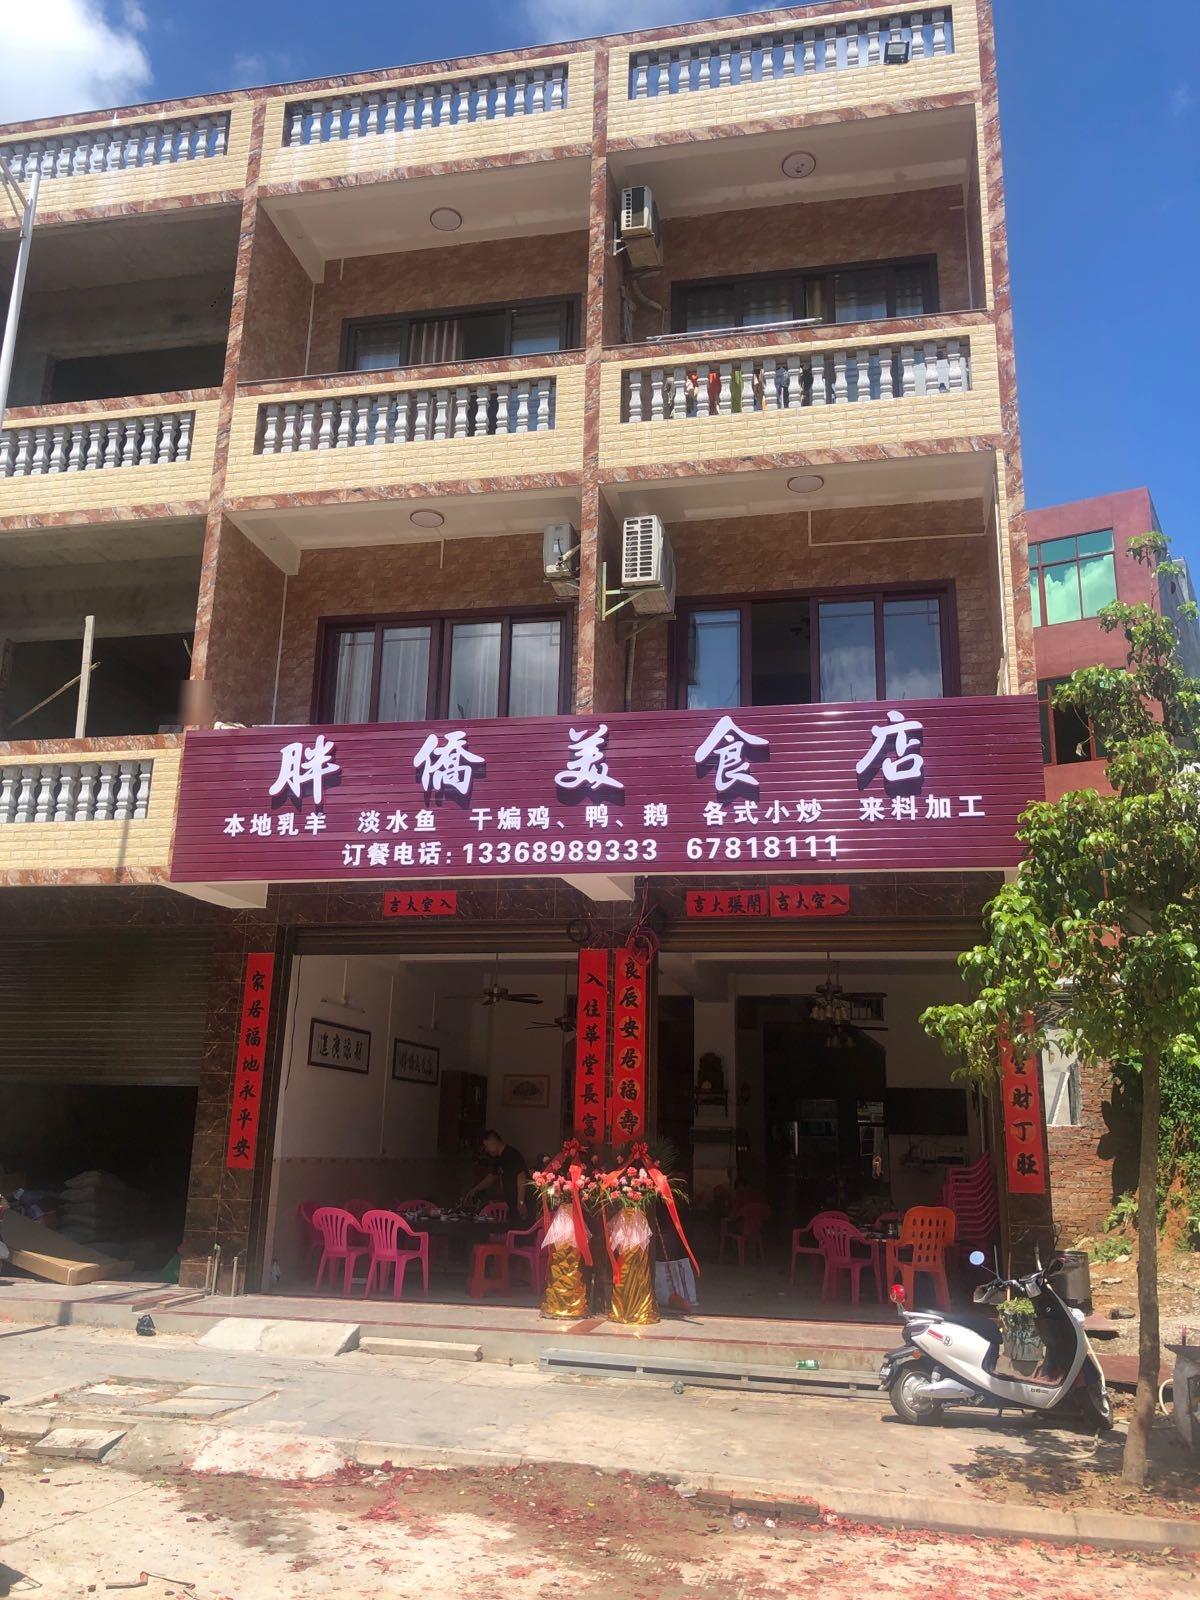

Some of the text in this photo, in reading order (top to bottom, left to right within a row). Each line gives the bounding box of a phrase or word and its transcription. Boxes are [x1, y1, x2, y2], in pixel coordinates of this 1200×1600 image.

[223, 812, 327, 837] 本地乳羊
[357, 809, 437, 834] 淡水鱼
[703, 799, 823, 826] 各式小炒
[859, 794, 986, 822] 来料加工
[686, 835, 838, 861] 67818111
[232, 970, 267, 1159] 家居福地永平安
